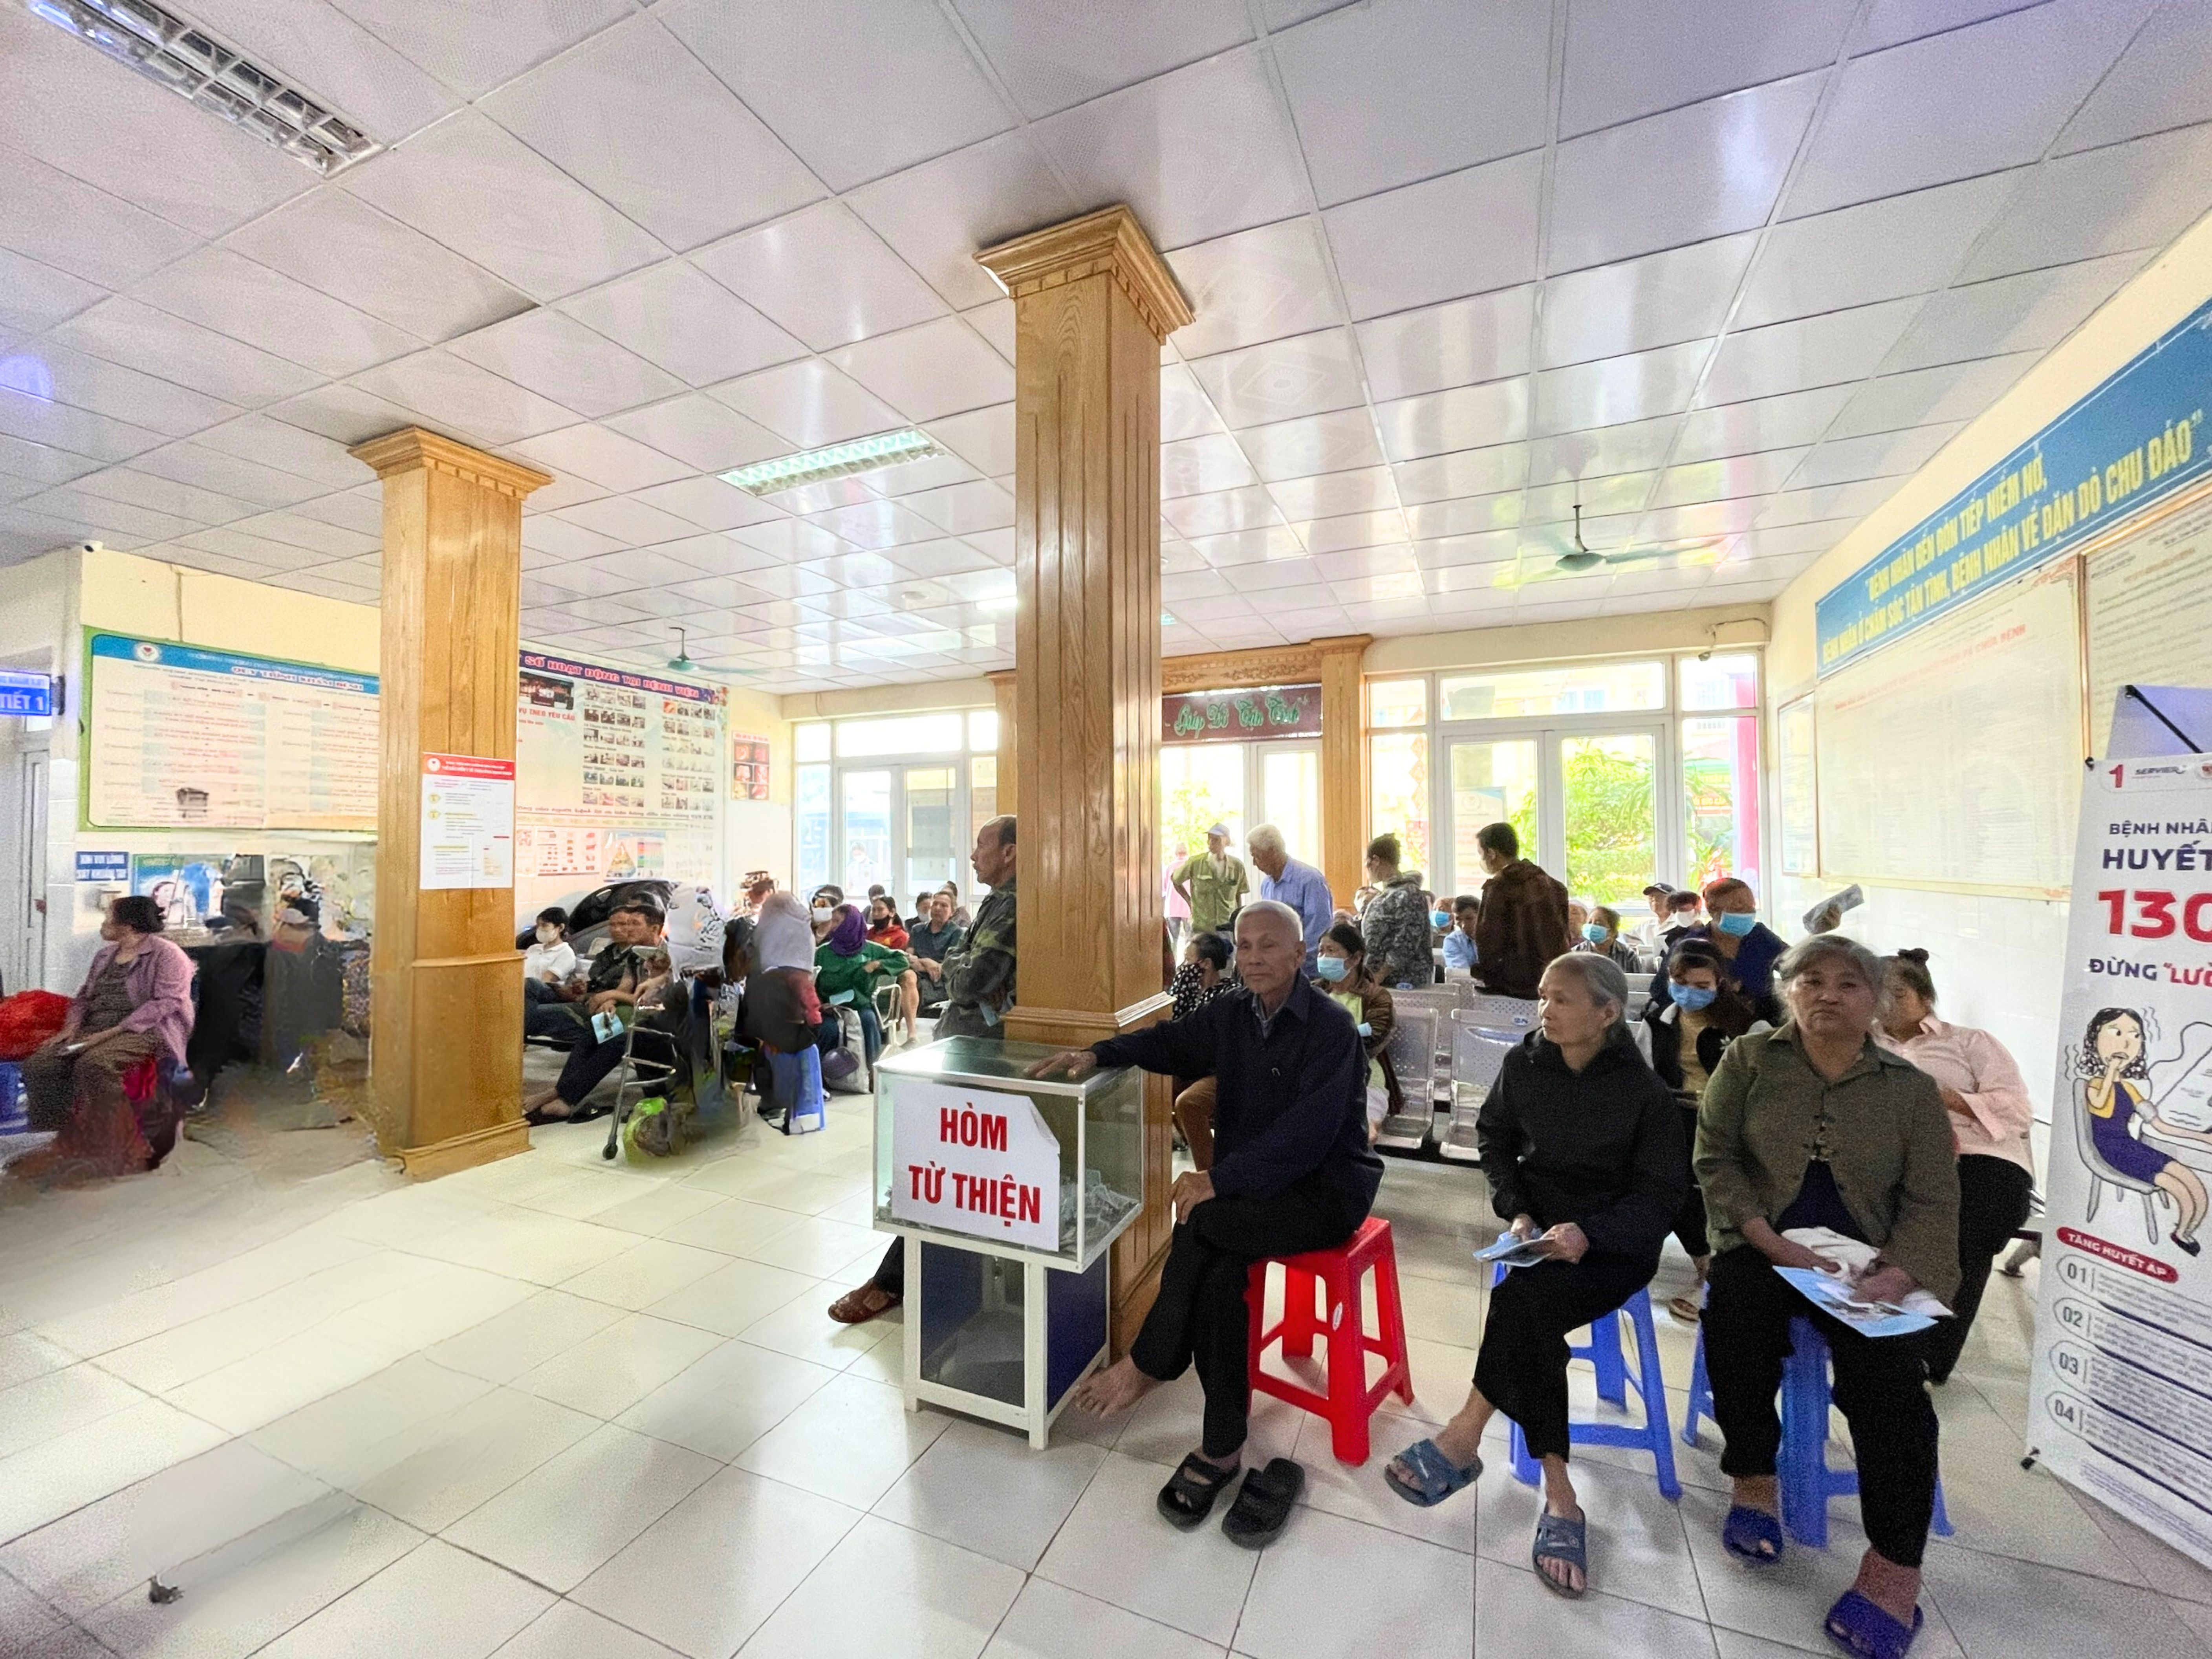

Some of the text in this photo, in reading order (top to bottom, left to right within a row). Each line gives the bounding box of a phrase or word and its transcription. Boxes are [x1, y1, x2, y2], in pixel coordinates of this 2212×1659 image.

[2106, 446, 2143, 504] CHU
[525, 656, 546, 667] SỐ
[35, 696, 44, 711] 1
[2109, 818, 2212, 837] BỆNH NHÂ
[2102, 840, 2212, 871] HUYẾT
[2089, 956, 2157, 981] ĐỪNG
[940, 1102, 1007, 1152] HÒM
[908, 1161, 1040, 1227] TỪ THIỆN
[2102, 1247, 2145, 1269] HUYẾT
[2067, 1262, 2086, 1284] 01
[2063, 1307, 2082, 1328] 02
[2059, 1353, 2078, 1375] 03
[2055, 1399, 2075, 1422] 04
